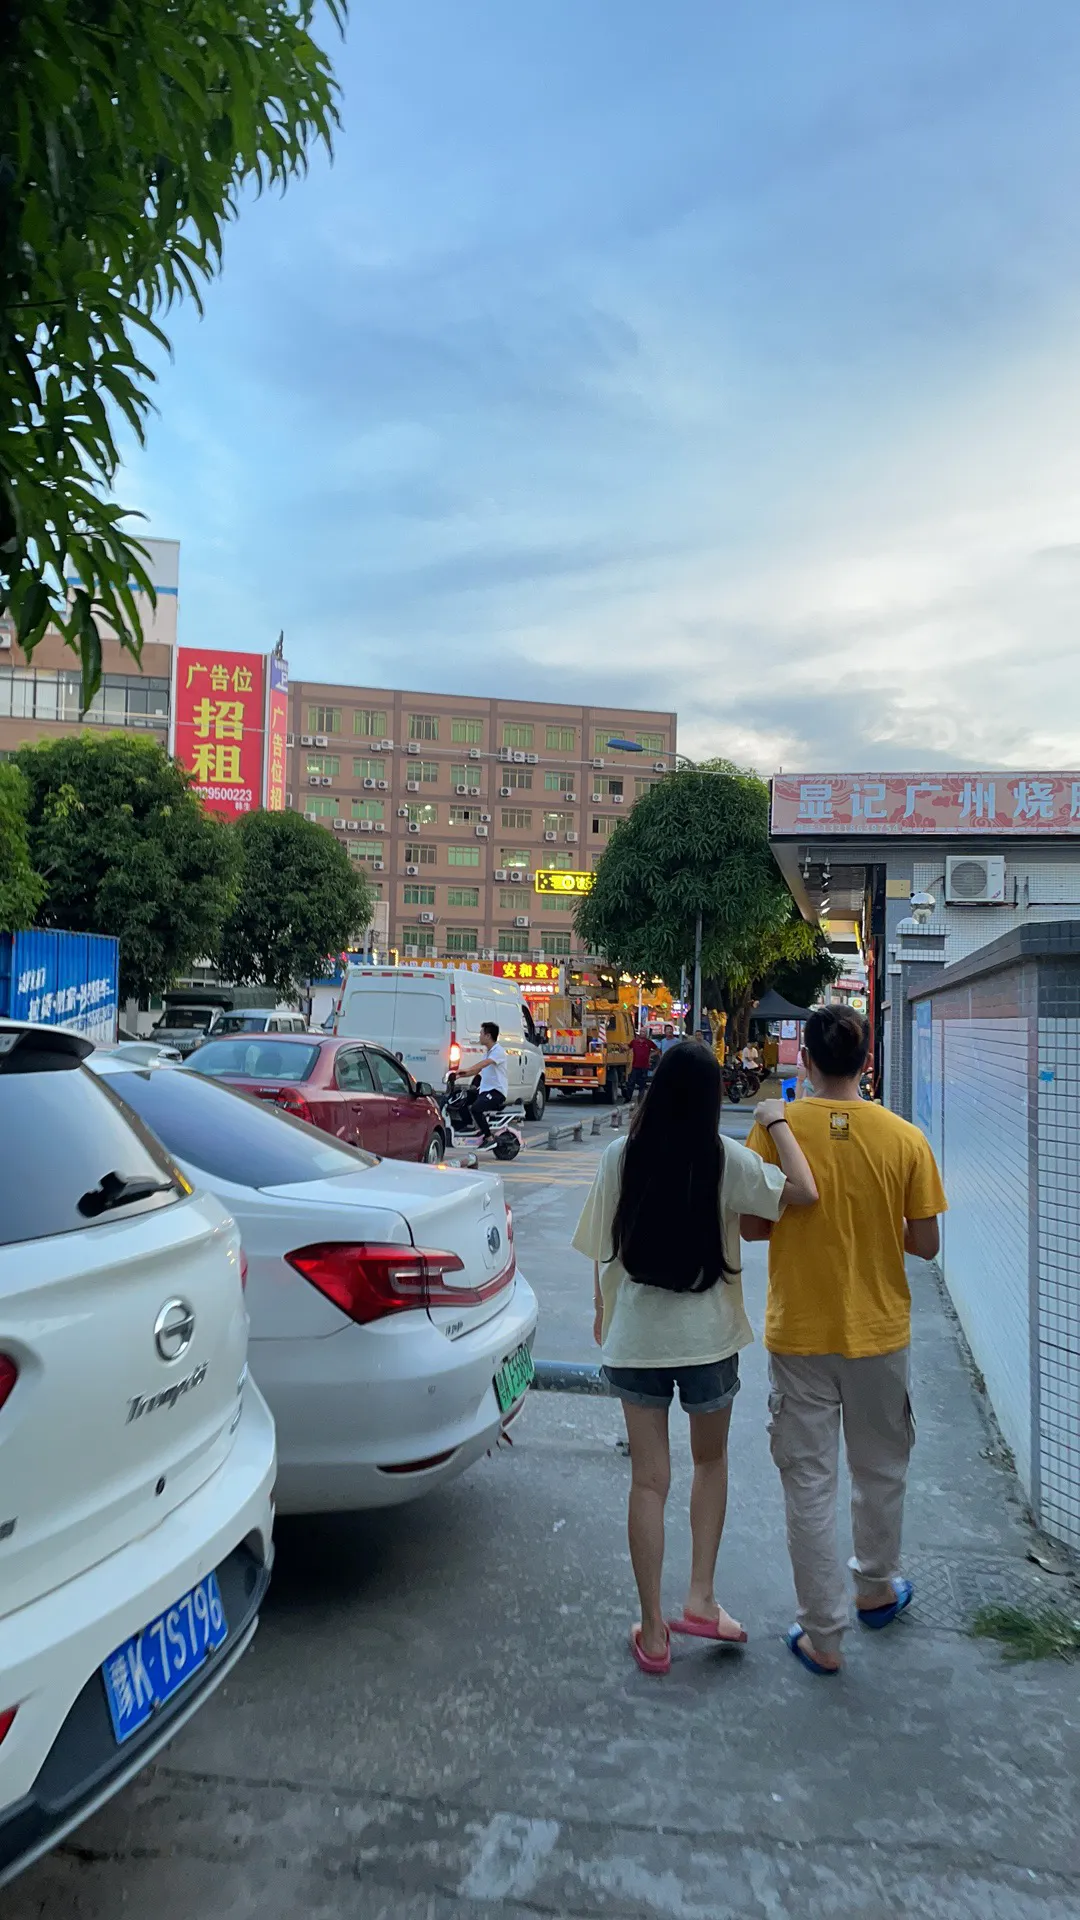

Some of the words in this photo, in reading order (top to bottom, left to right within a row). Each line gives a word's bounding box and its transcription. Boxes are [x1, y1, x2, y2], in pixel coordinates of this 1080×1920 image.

[185, 661, 253, 693] 广告位
[191, 696, 245, 784] 招租
